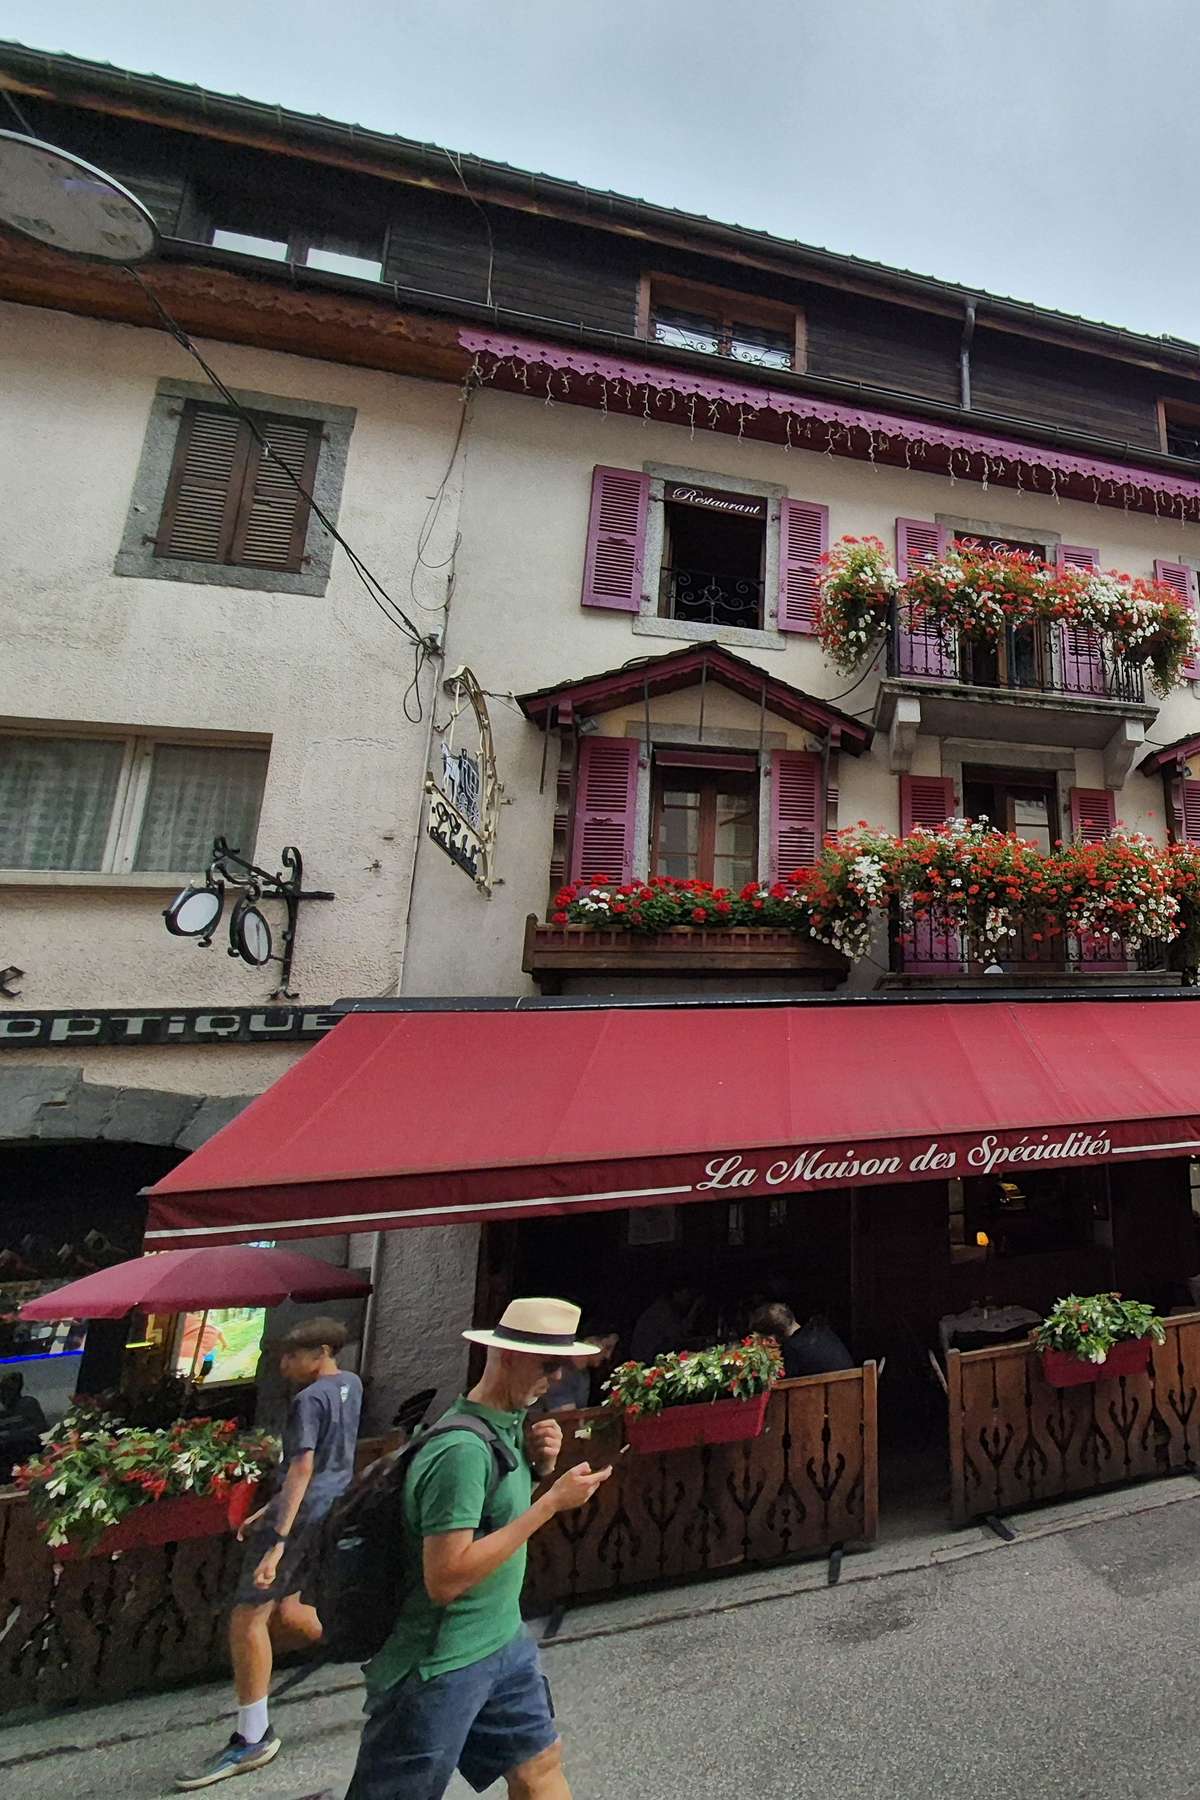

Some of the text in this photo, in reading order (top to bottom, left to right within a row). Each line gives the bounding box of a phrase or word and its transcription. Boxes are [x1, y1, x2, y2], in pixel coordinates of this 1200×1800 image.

[672, 487, 760, 514] Restaurant
[696, 1130, 1111, 1191] La Maison des Spécialités
